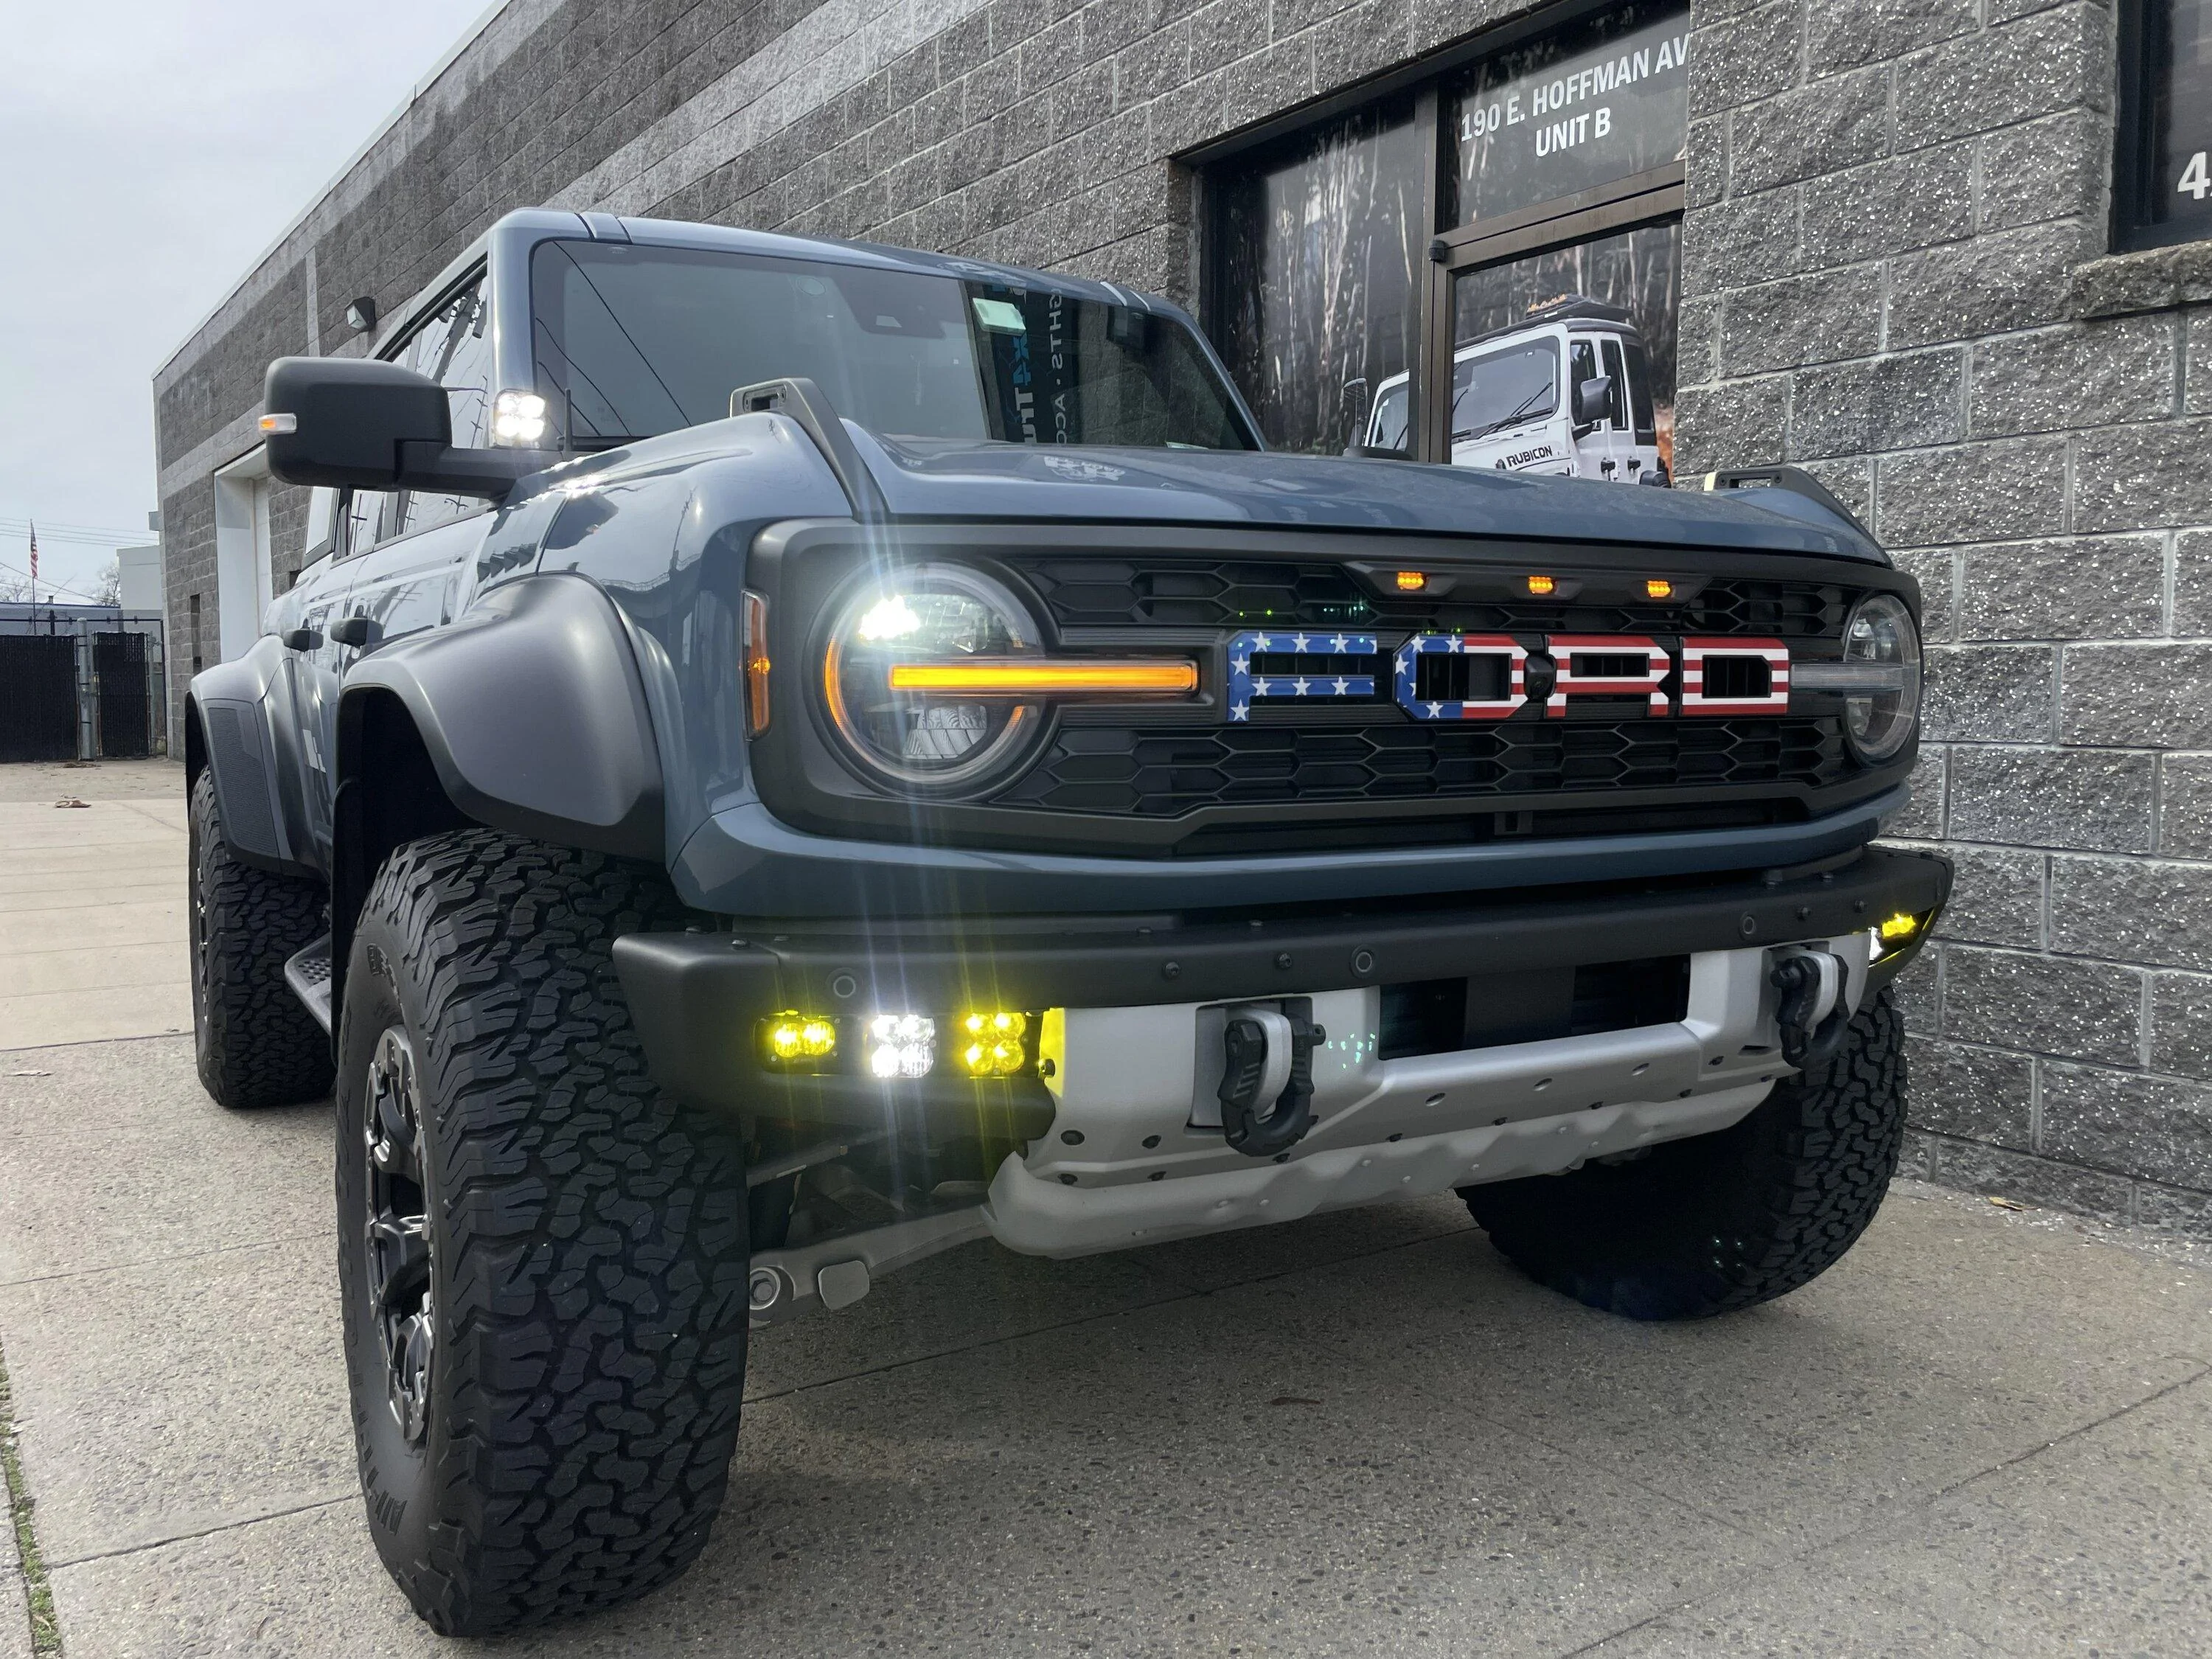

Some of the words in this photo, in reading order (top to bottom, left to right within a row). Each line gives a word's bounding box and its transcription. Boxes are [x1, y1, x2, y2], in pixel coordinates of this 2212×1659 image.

[1461, 103, 1500, 142] 190
[1506, 96, 1526, 126] E.
[1532, 48, 1649, 116] HOFFMAN
[1536, 114, 1590, 157] UNIT
[1594, 107, 1611, 139] B
[2177, 152, 2212, 200] 4
[1506, 445, 1553, 467] RUBICON
[1227, 633, 1789, 723] FORD
